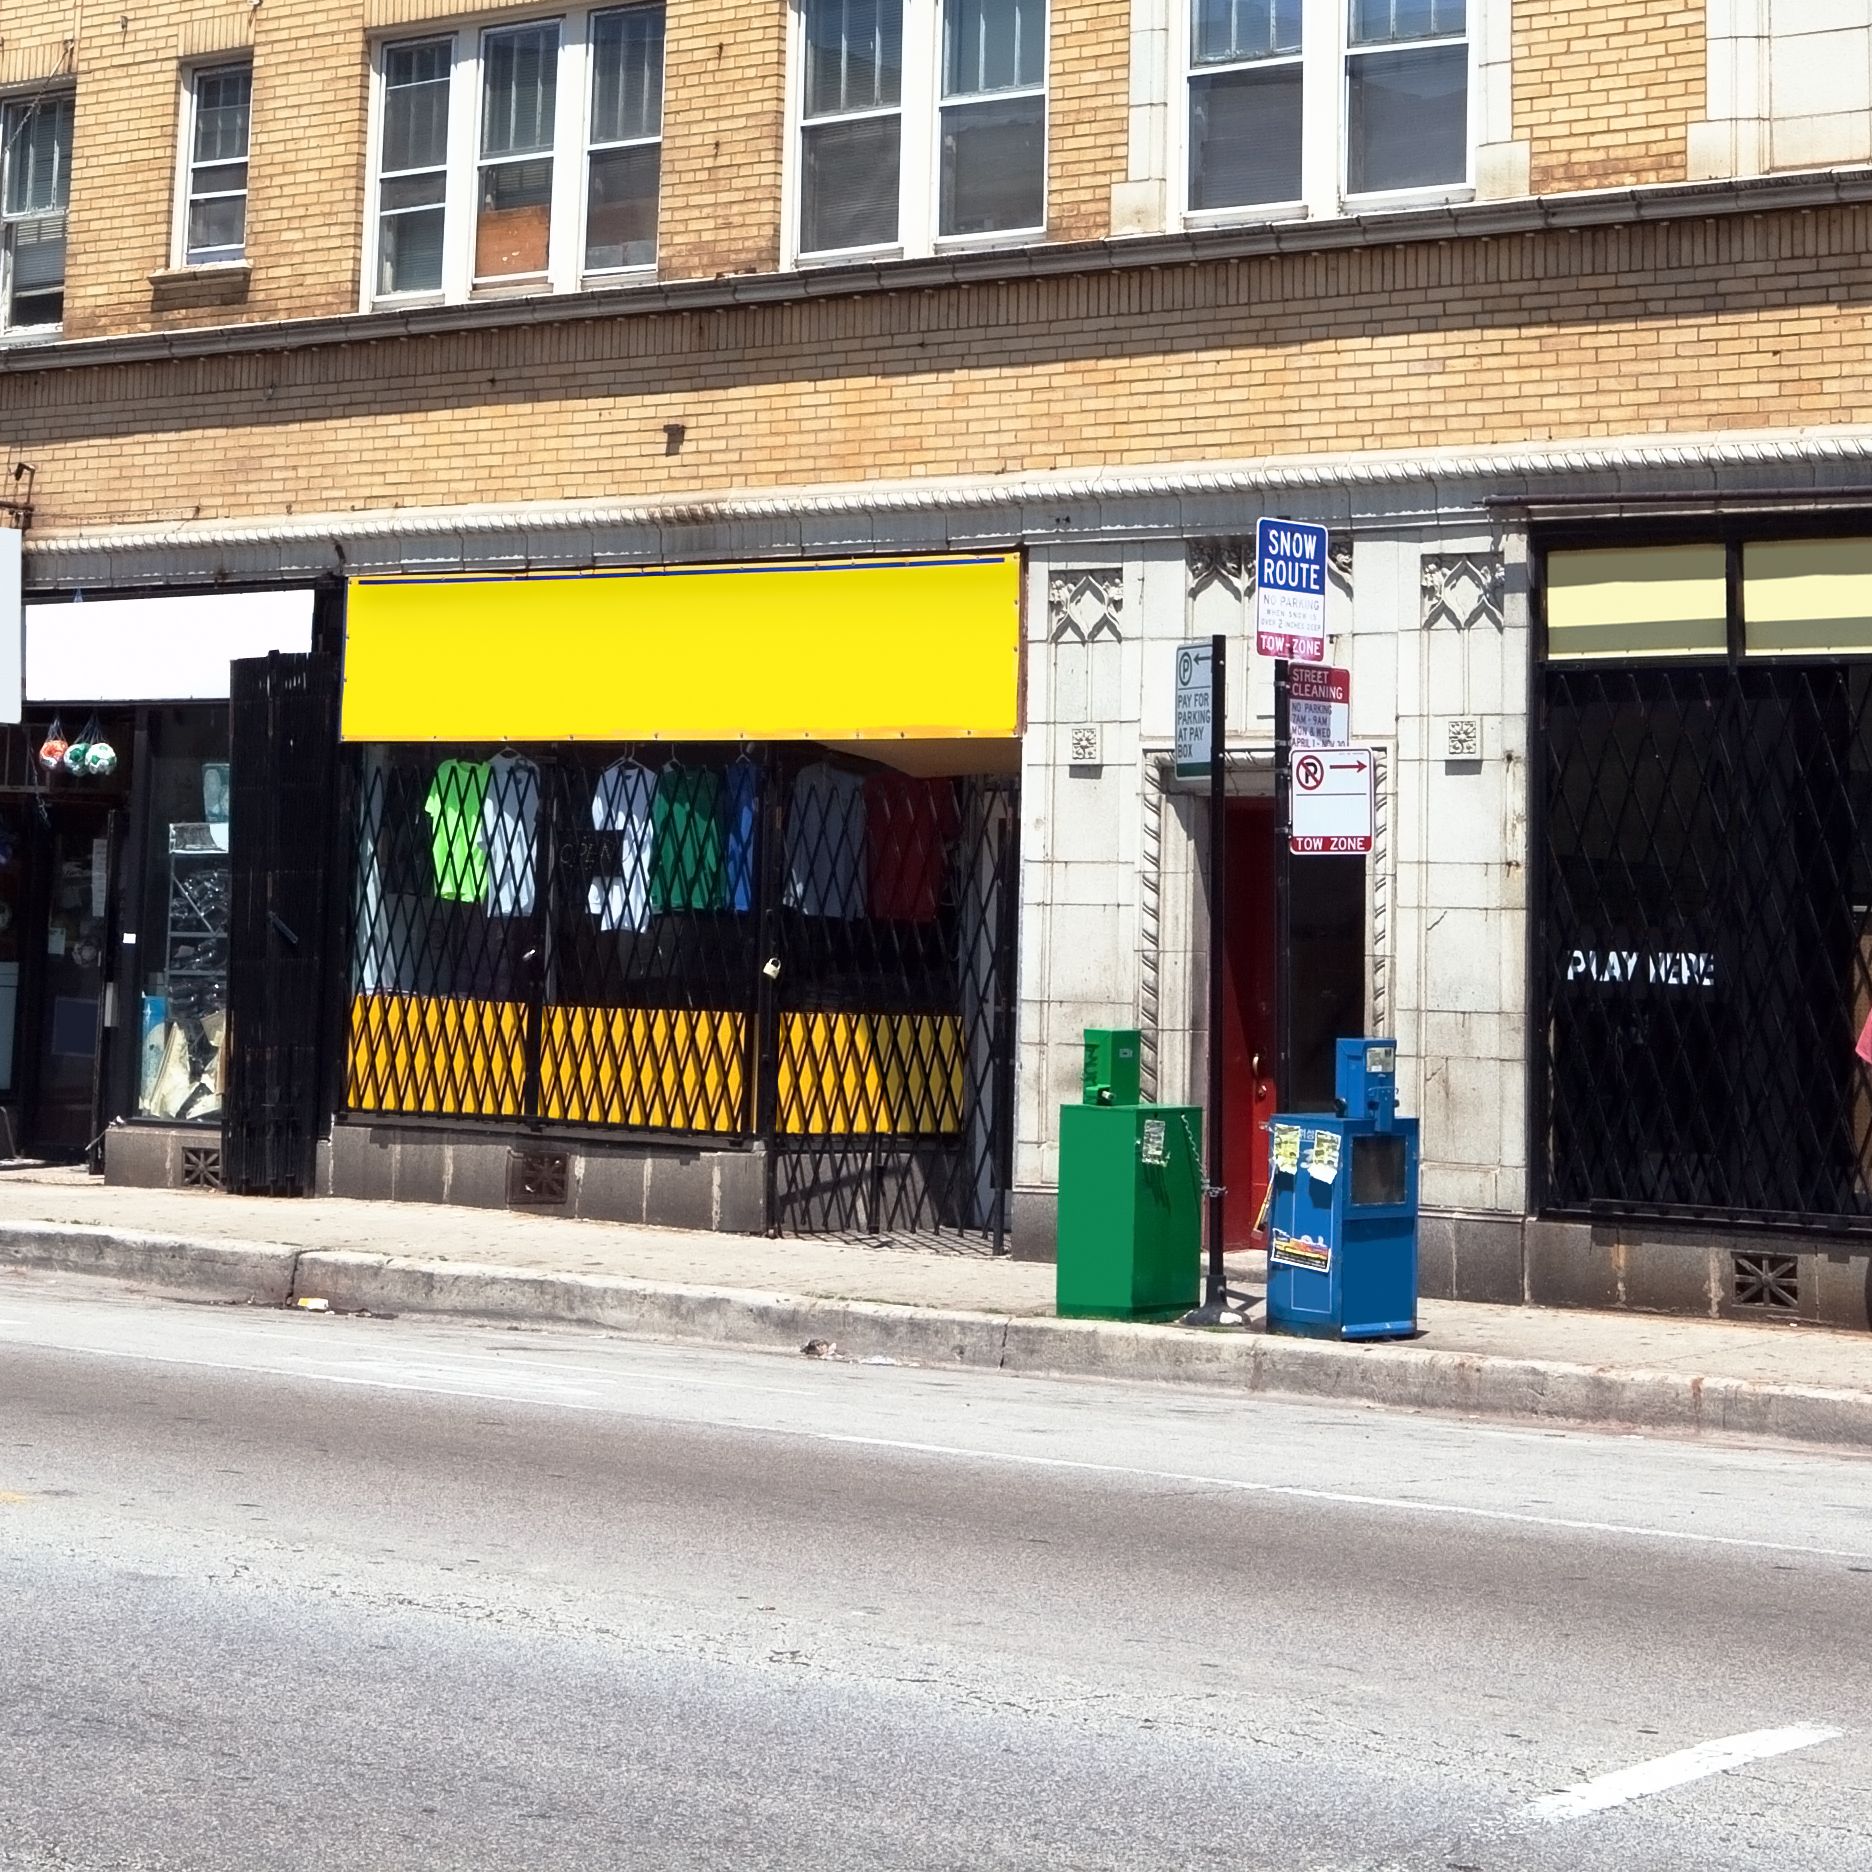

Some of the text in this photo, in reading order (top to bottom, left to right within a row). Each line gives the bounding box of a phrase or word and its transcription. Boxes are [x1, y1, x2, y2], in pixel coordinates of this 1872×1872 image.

[1268, 529, 1317, 560] SNOW
[1263, 558, 1320, 590] ROUTE
[1264, 594, 1320, 612] NO PARKING
[1292, 669, 1329, 684] STREET
[1292, 683, 1343, 700] CLEANING
[1178, 693, 1210, 707] PAY FOR
[1292, 703, 1332, 715] NO PARKING
[1178, 709, 1211, 726] PARKING
[1292, 714, 1307, 725] 7AM
[1313, 716, 1328, 725] 9AM
[1178, 726, 1204, 742] AT PAY
[1292, 726, 1307, 736] MON
[1317, 728, 1331, 738] WED
[1178, 744, 1193, 758] BOX
[1296, 837, 1365, 851] TOW ZONE
[1567, 950, 1639, 982] PLAY
